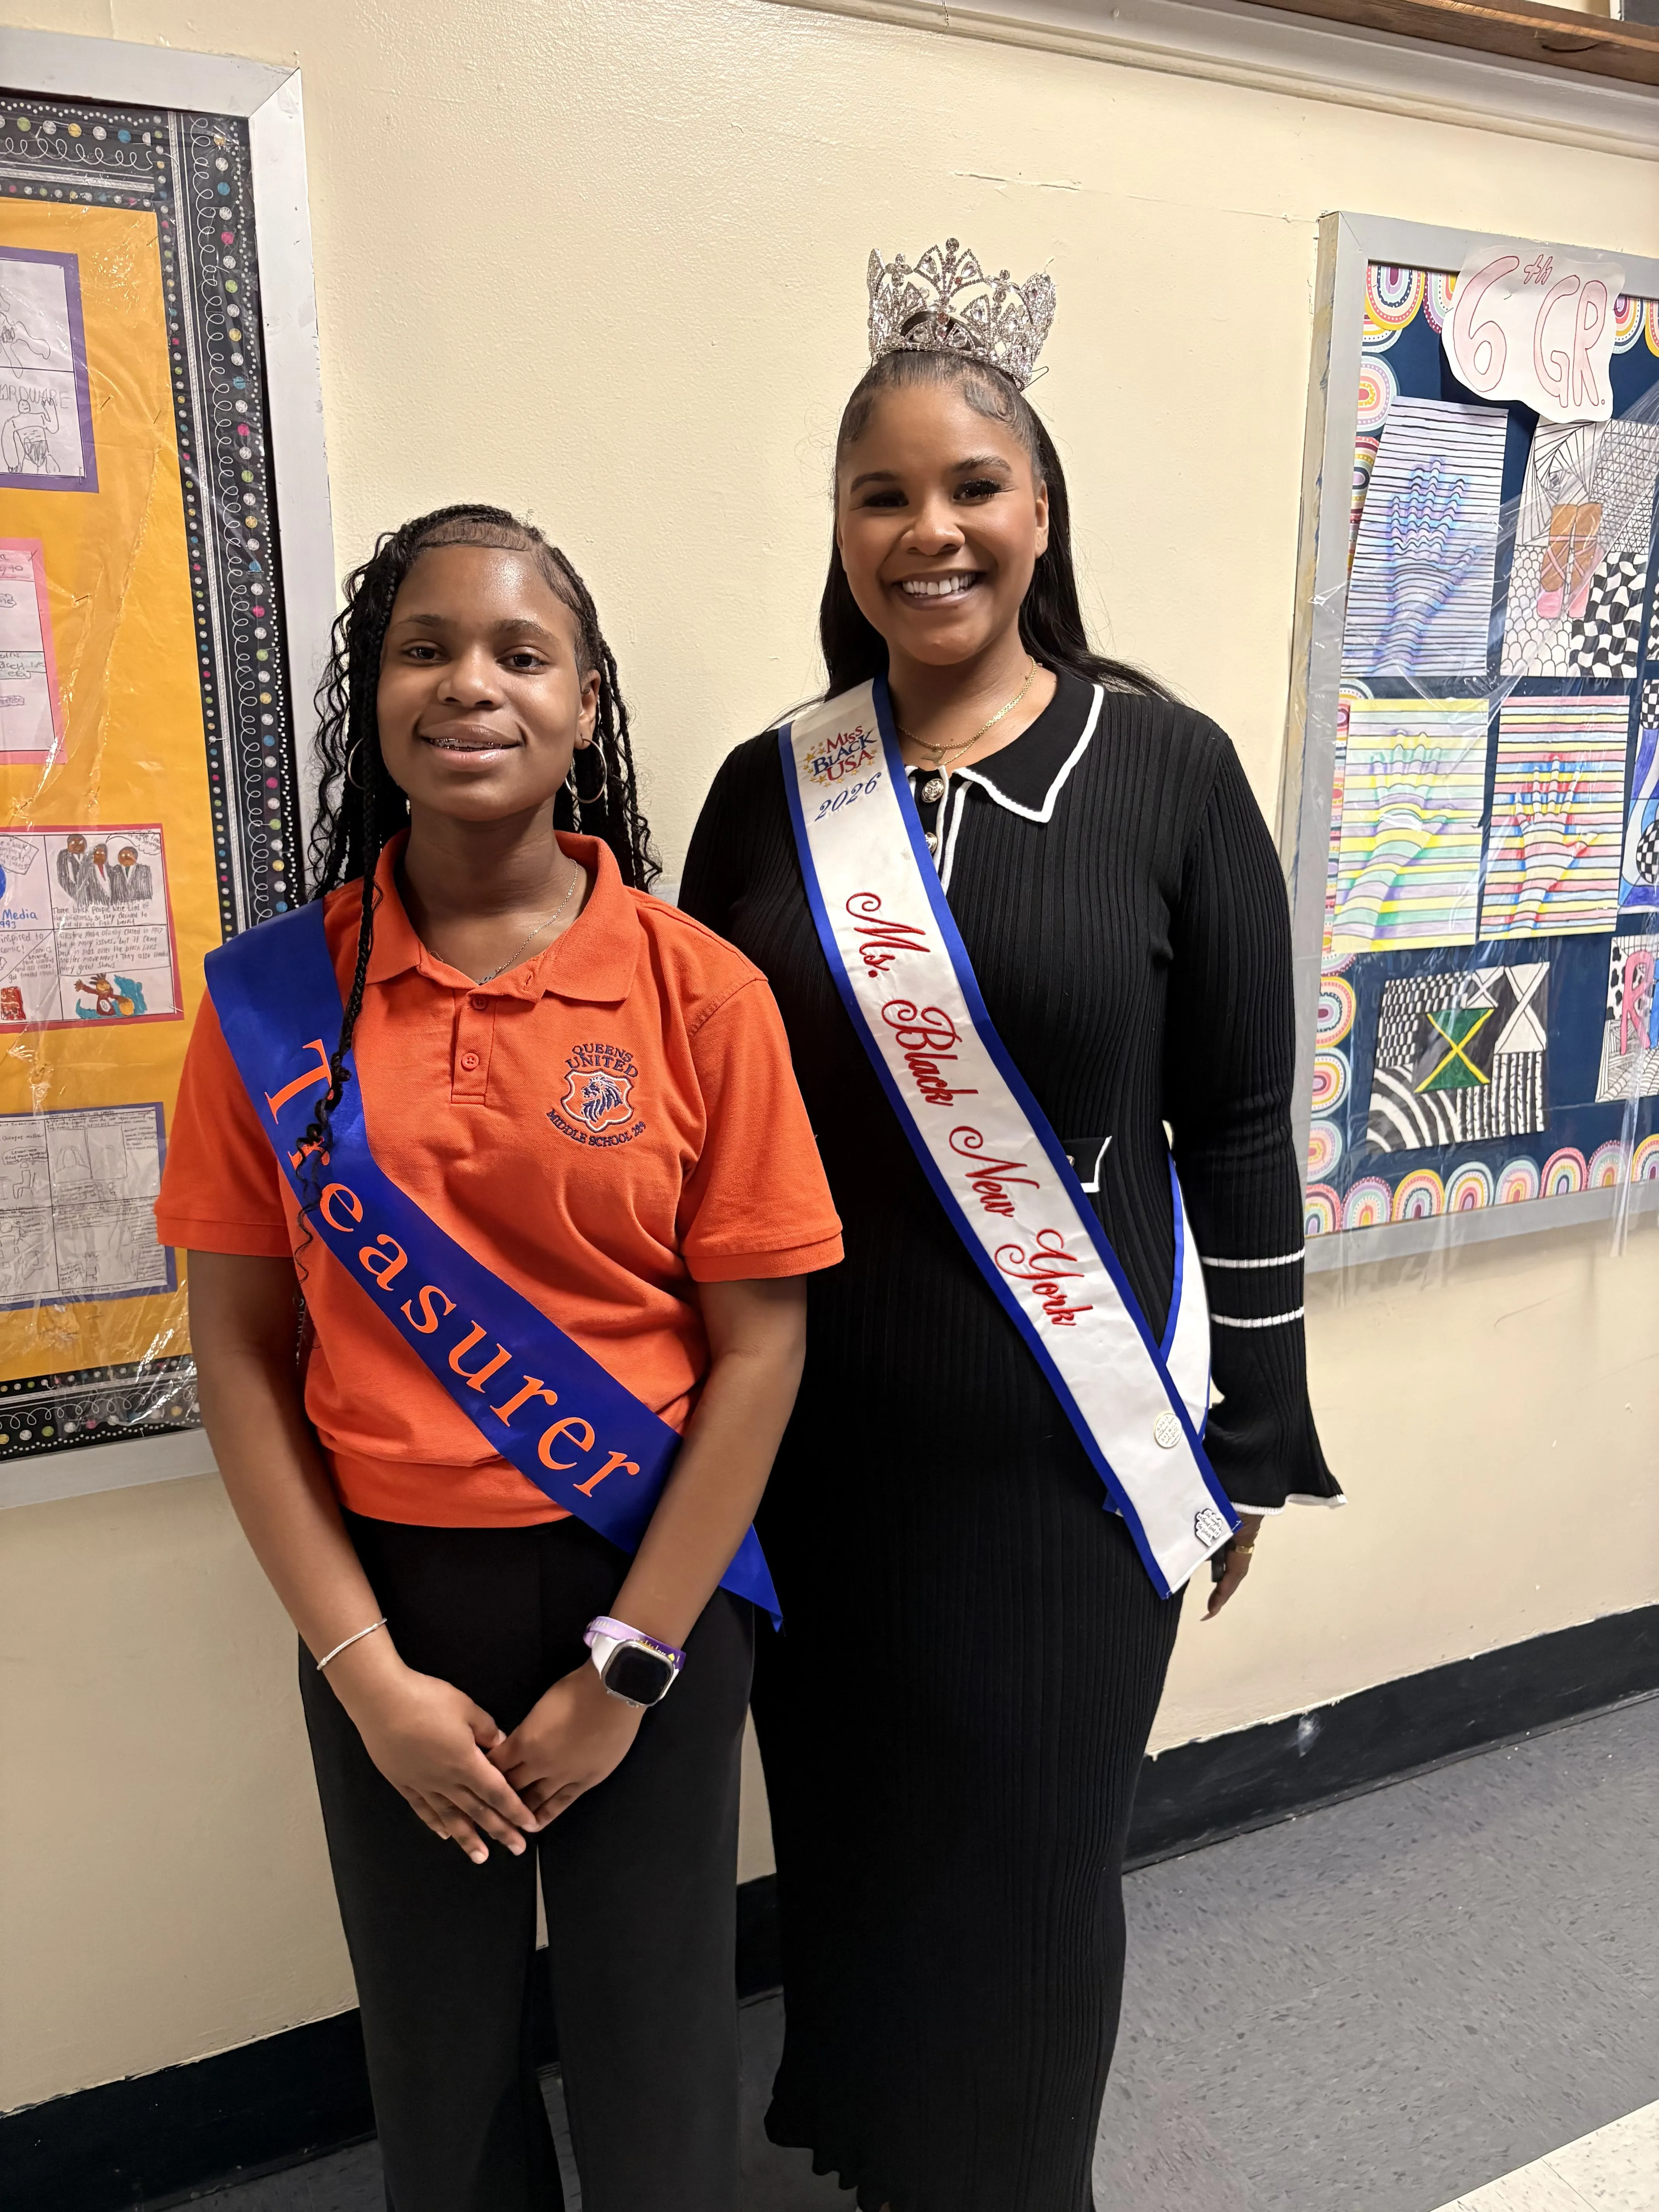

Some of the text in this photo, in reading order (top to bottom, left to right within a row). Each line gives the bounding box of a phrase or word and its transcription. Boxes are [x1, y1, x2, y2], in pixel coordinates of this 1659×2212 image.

[0, 384, 72, 409] ARDWARE
[811, 730, 878, 777] BLACK
[824, 749, 876, 781] USA
[814, 772, 882, 822] 2026
[0, 920, 16, 929] 993
[2, 908, 38, 921] Media
[1, 933, 31, 945] inspired
[565, 1054, 639, 1078] UNITED
[571, 1042, 634, 1063] QUEENS
[846, 892, 1094, 1326] Ms. Black New York
[546, 1108, 588, 1144] MIDDLE
[588, 1131, 632, 1147] SCHOOL
[264, 1038, 641, 1498] Treasurer
